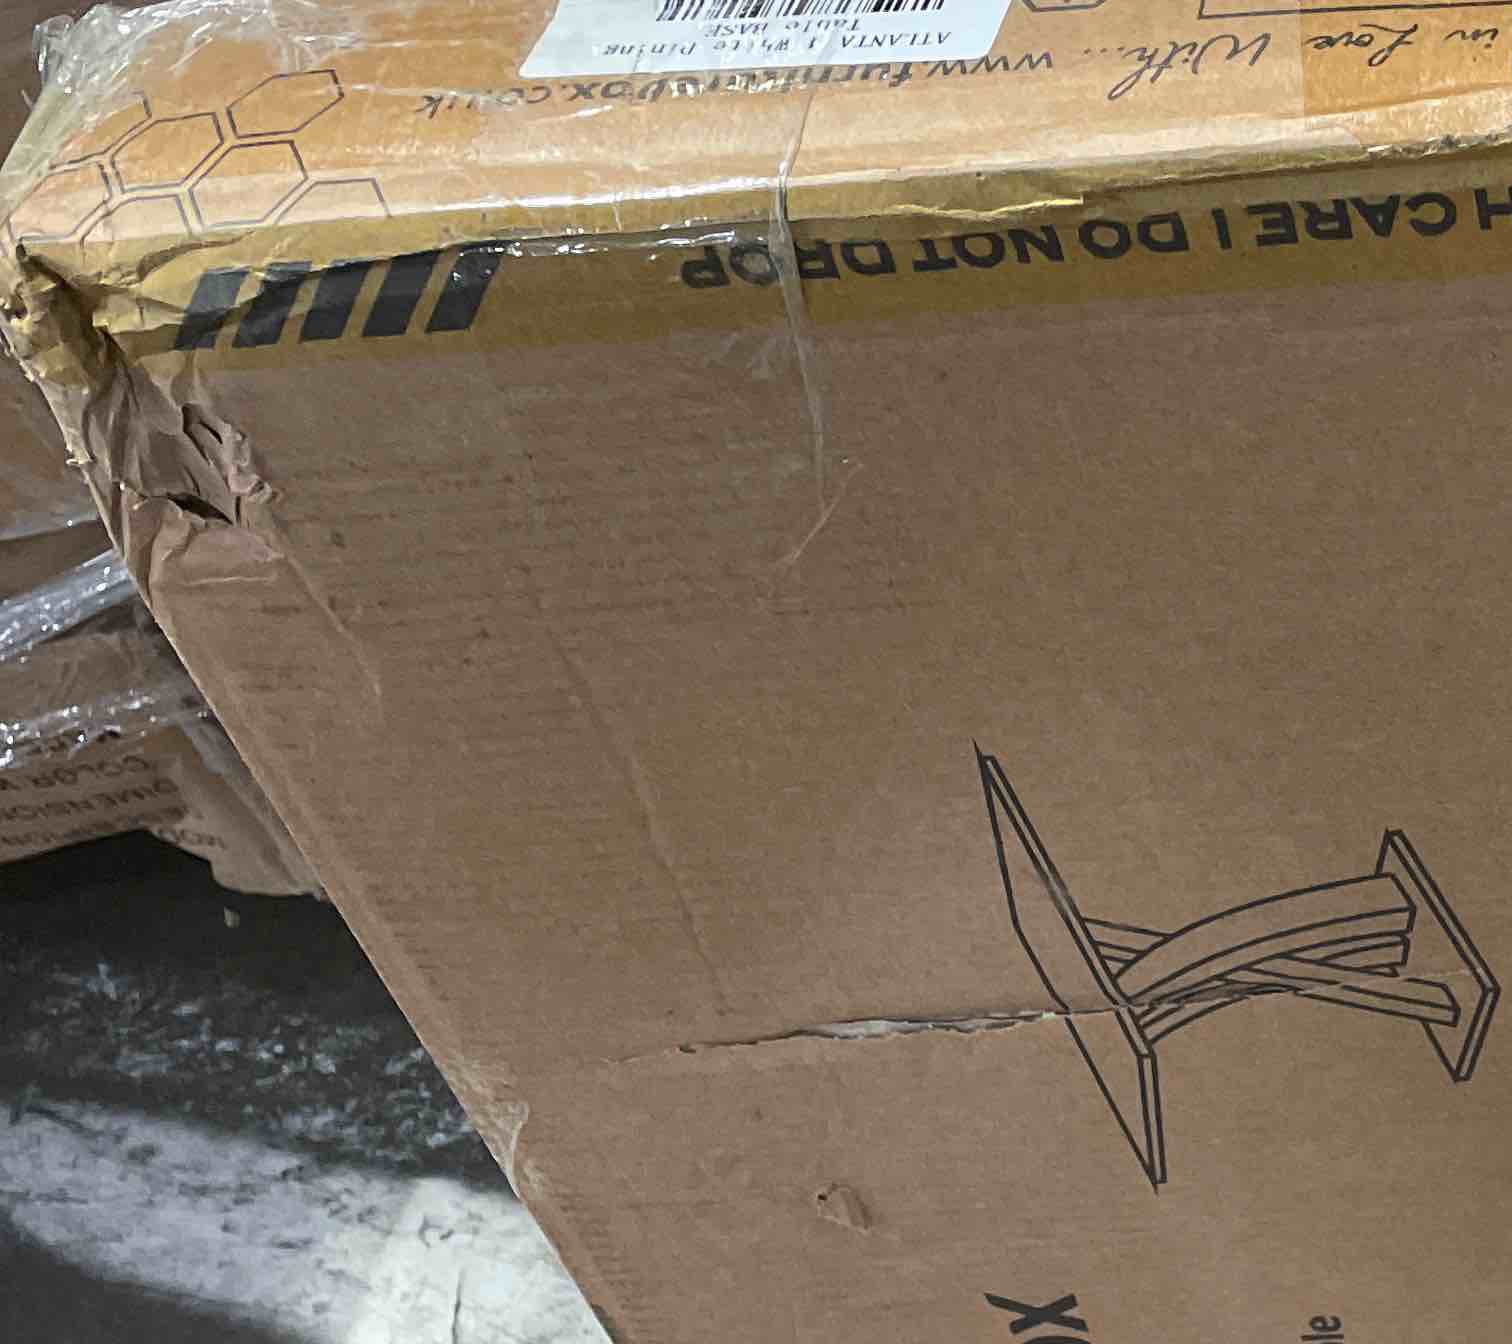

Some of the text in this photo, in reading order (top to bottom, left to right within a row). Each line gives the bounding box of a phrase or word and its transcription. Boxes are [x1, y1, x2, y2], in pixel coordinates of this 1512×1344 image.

[840, 25, 953, 53] ATLANTA
[1304, 21, 1425, 69] Love
[1445, 26, 1498, 47] in
[1077, 210, 1189, 259] DO
[1254, 191, 1457, 249] CARE
[680, 238, 897, 290] DROP
[912, 222, 1064, 274] NOT
